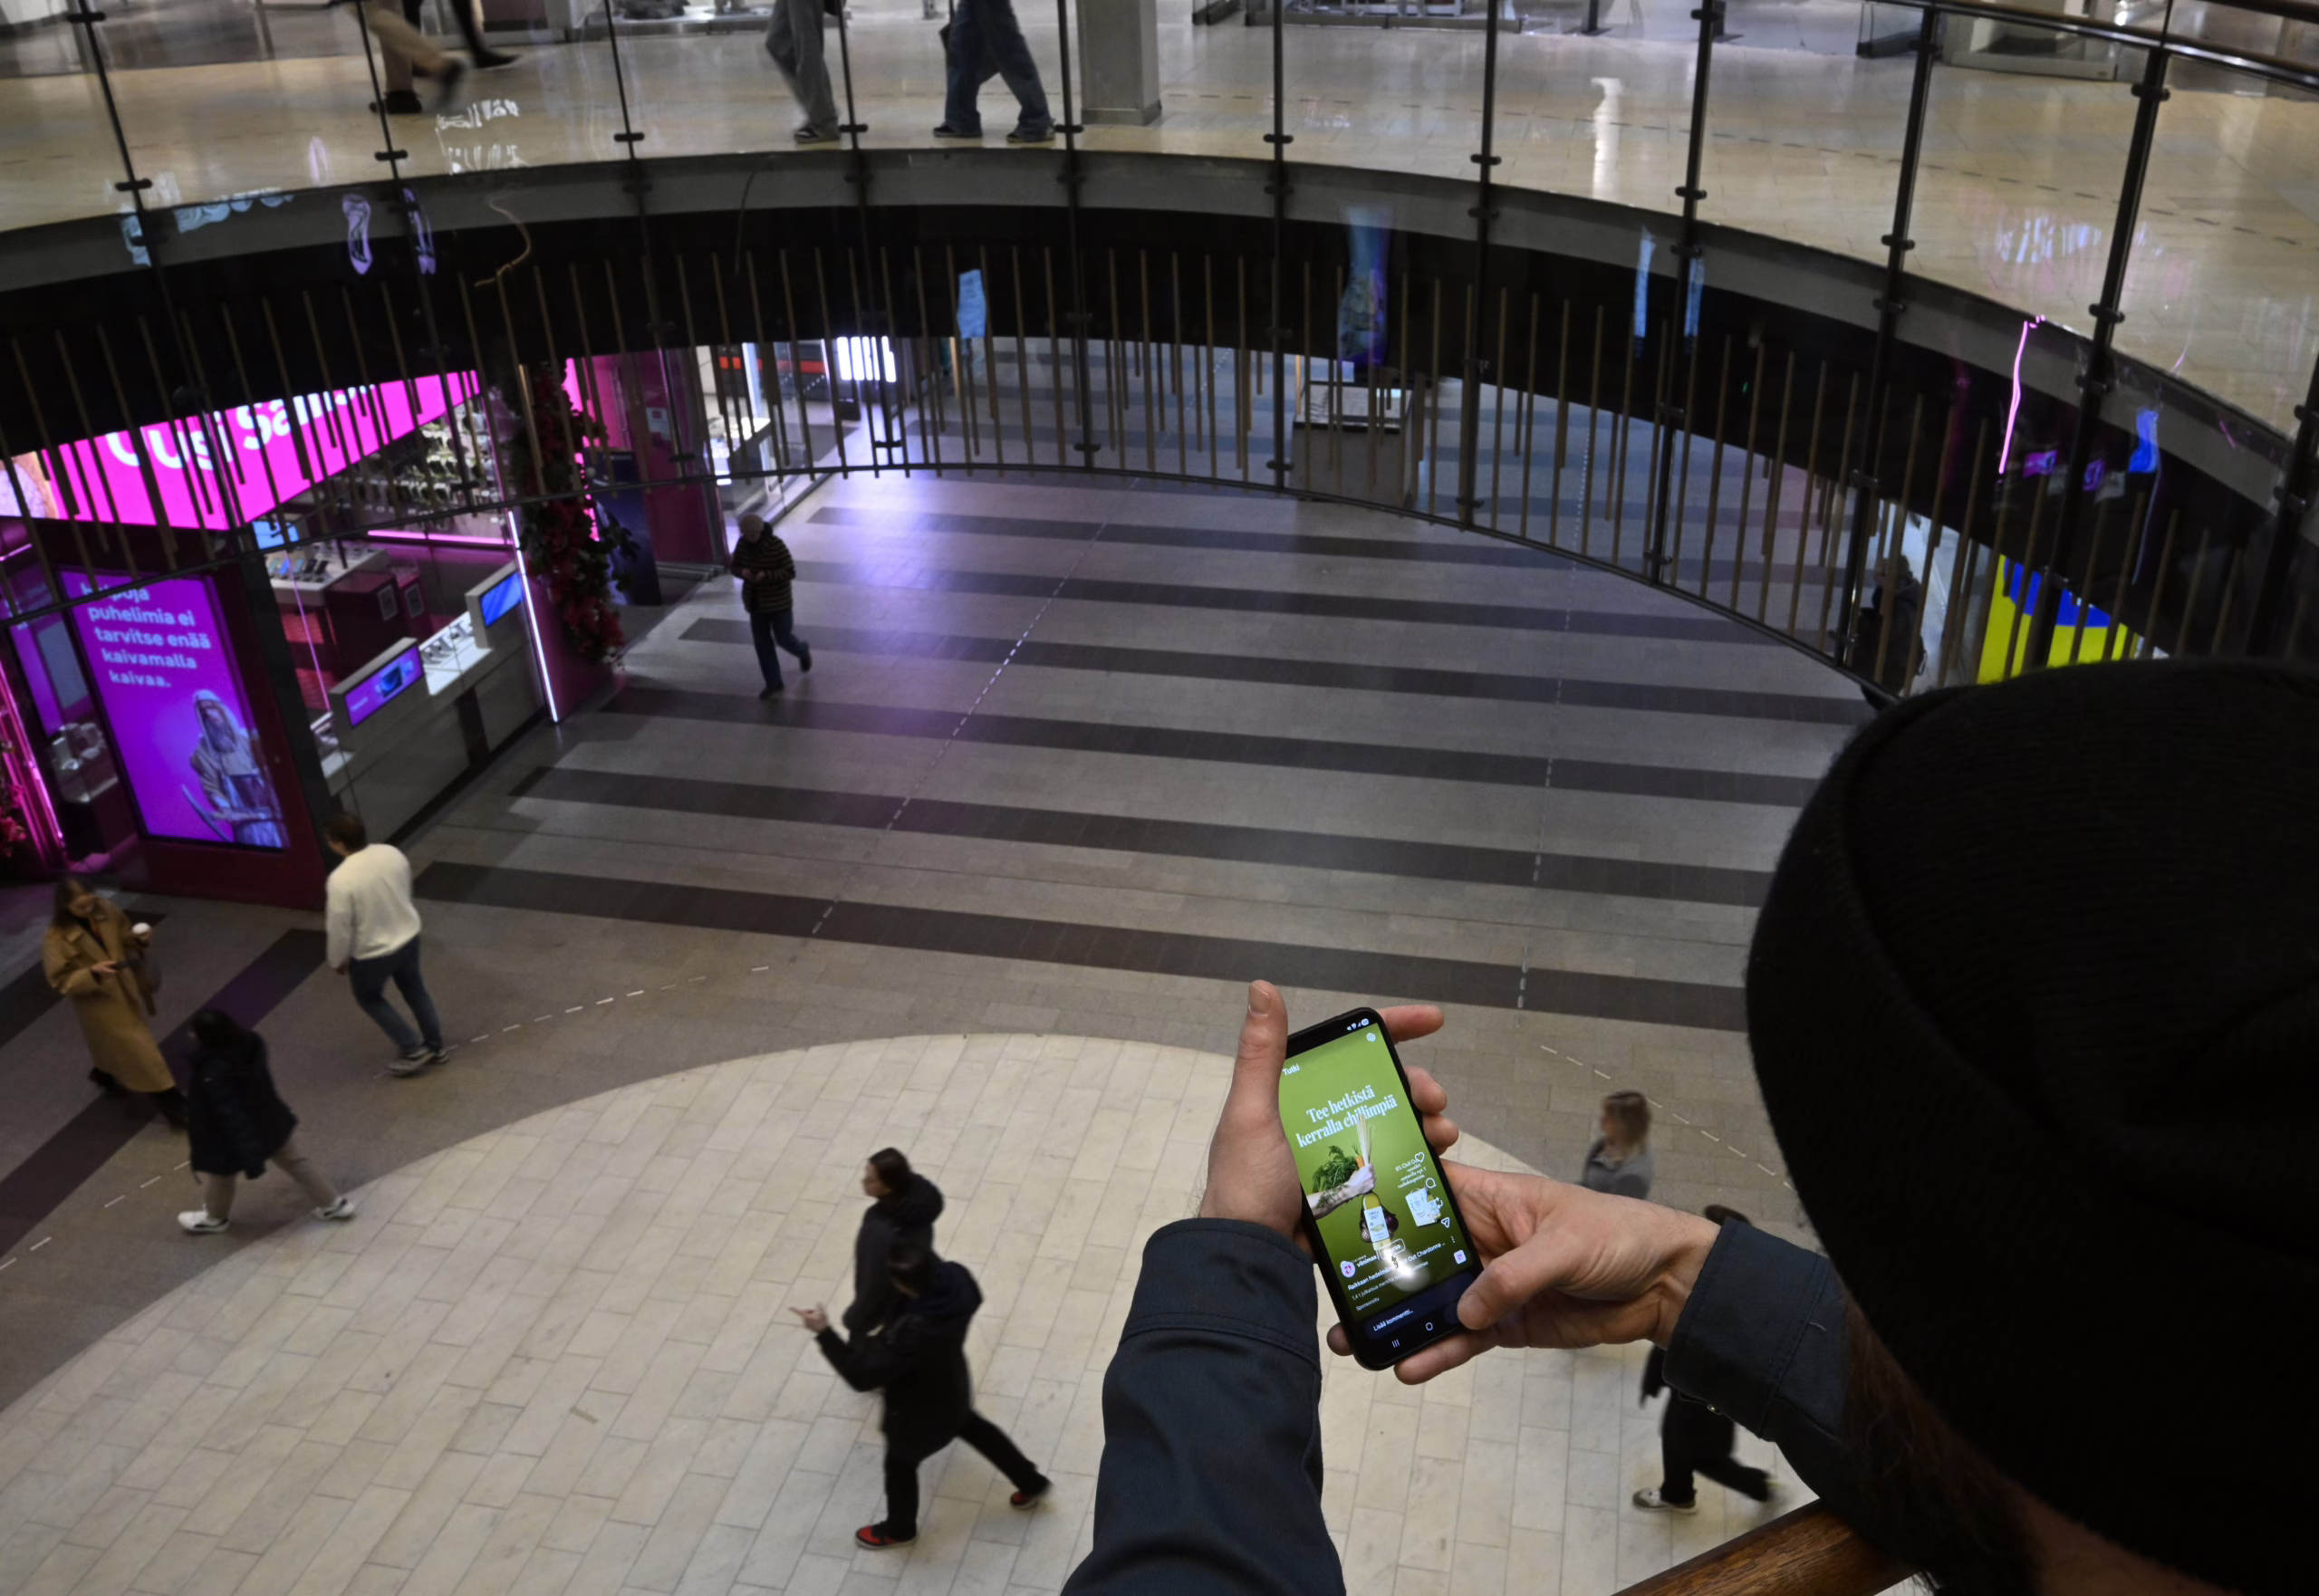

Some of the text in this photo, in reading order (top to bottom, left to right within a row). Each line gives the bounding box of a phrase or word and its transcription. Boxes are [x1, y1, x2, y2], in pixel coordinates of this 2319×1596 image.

[88, 605, 196, 627] puhelimia ei
[94, 626, 212, 649] tarvitse enää
[101, 647, 197, 669] kaivamalla
[109, 669, 172, 687] kaivaa.
[1282, 1063, 1301, 1076] Tutki
[1306, 1084, 1376, 1123] Tee hetkistä
[1295, 1094, 1398, 1148] kerralla chillimpiä
[1357, 1255, 1377, 1267] viinimaa
[1355, 1297, 1381, 1312] Sponsoroitu
[1372, 1320, 1387, 1332] Lisää
